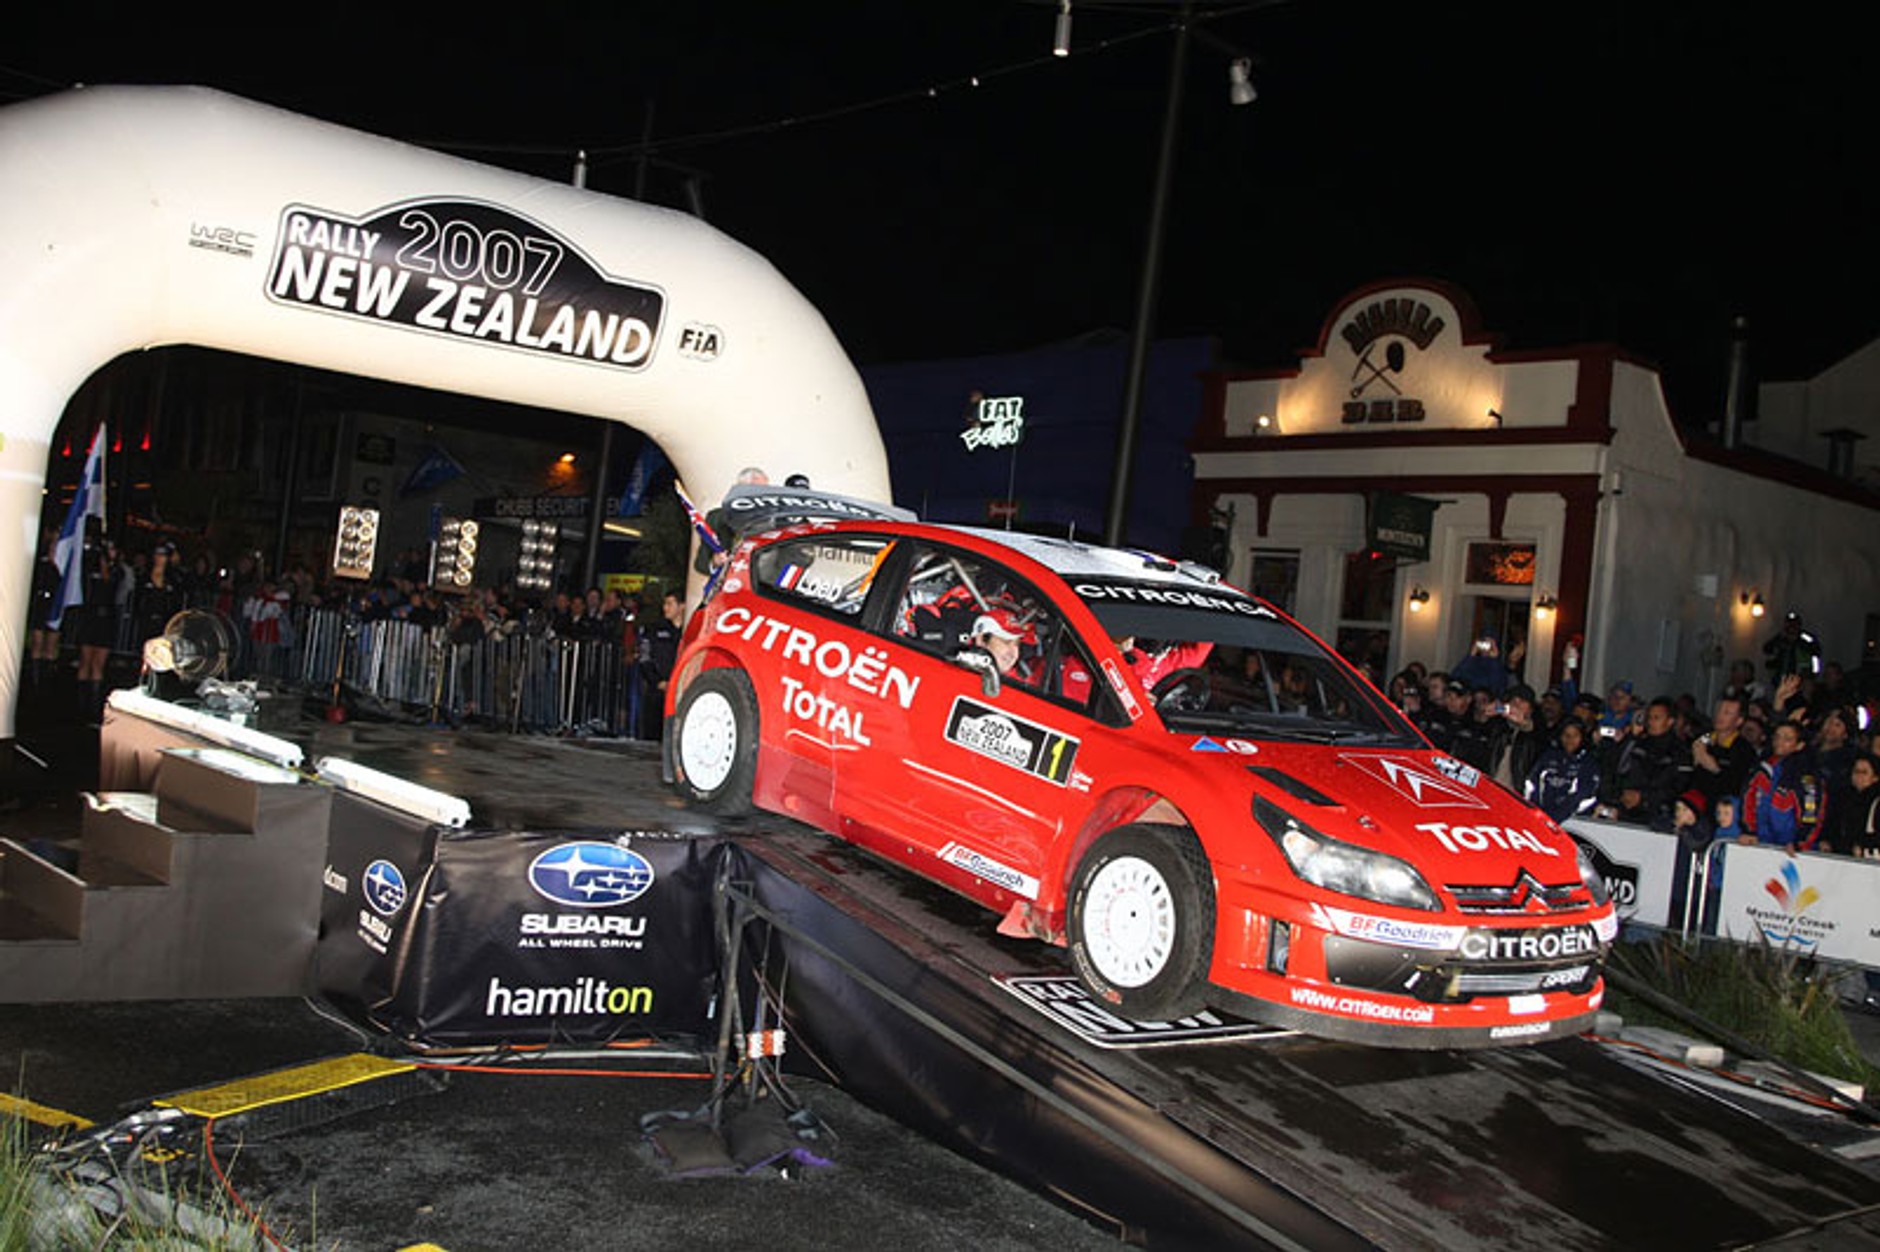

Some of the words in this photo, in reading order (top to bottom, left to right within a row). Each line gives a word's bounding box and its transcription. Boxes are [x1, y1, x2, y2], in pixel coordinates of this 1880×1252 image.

[289, 214, 381, 260] RALLY
[395, 210, 563, 297] 2007
[275, 246, 410, 319] NEW
[415, 277, 653, 366] ZEALAND
[716, 607, 921, 709] CITROËN
[781, 675, 871, 747] TOTAL
[979, 718, 1013, 742] 2007
[1049, 735, 1067, 780] 1
[1414, 822, 1560, 857] TOTAL
[518, 937, 546, 948] ALL
[549, 938, 598, 948] WHEEL
[599, 938, 644, 949] DRIVE
[519, 913, 647, 937] SUBARU
[1459, 925, 1594, 960] CITROËN
[486, 977, 654, 1016] hamilton
